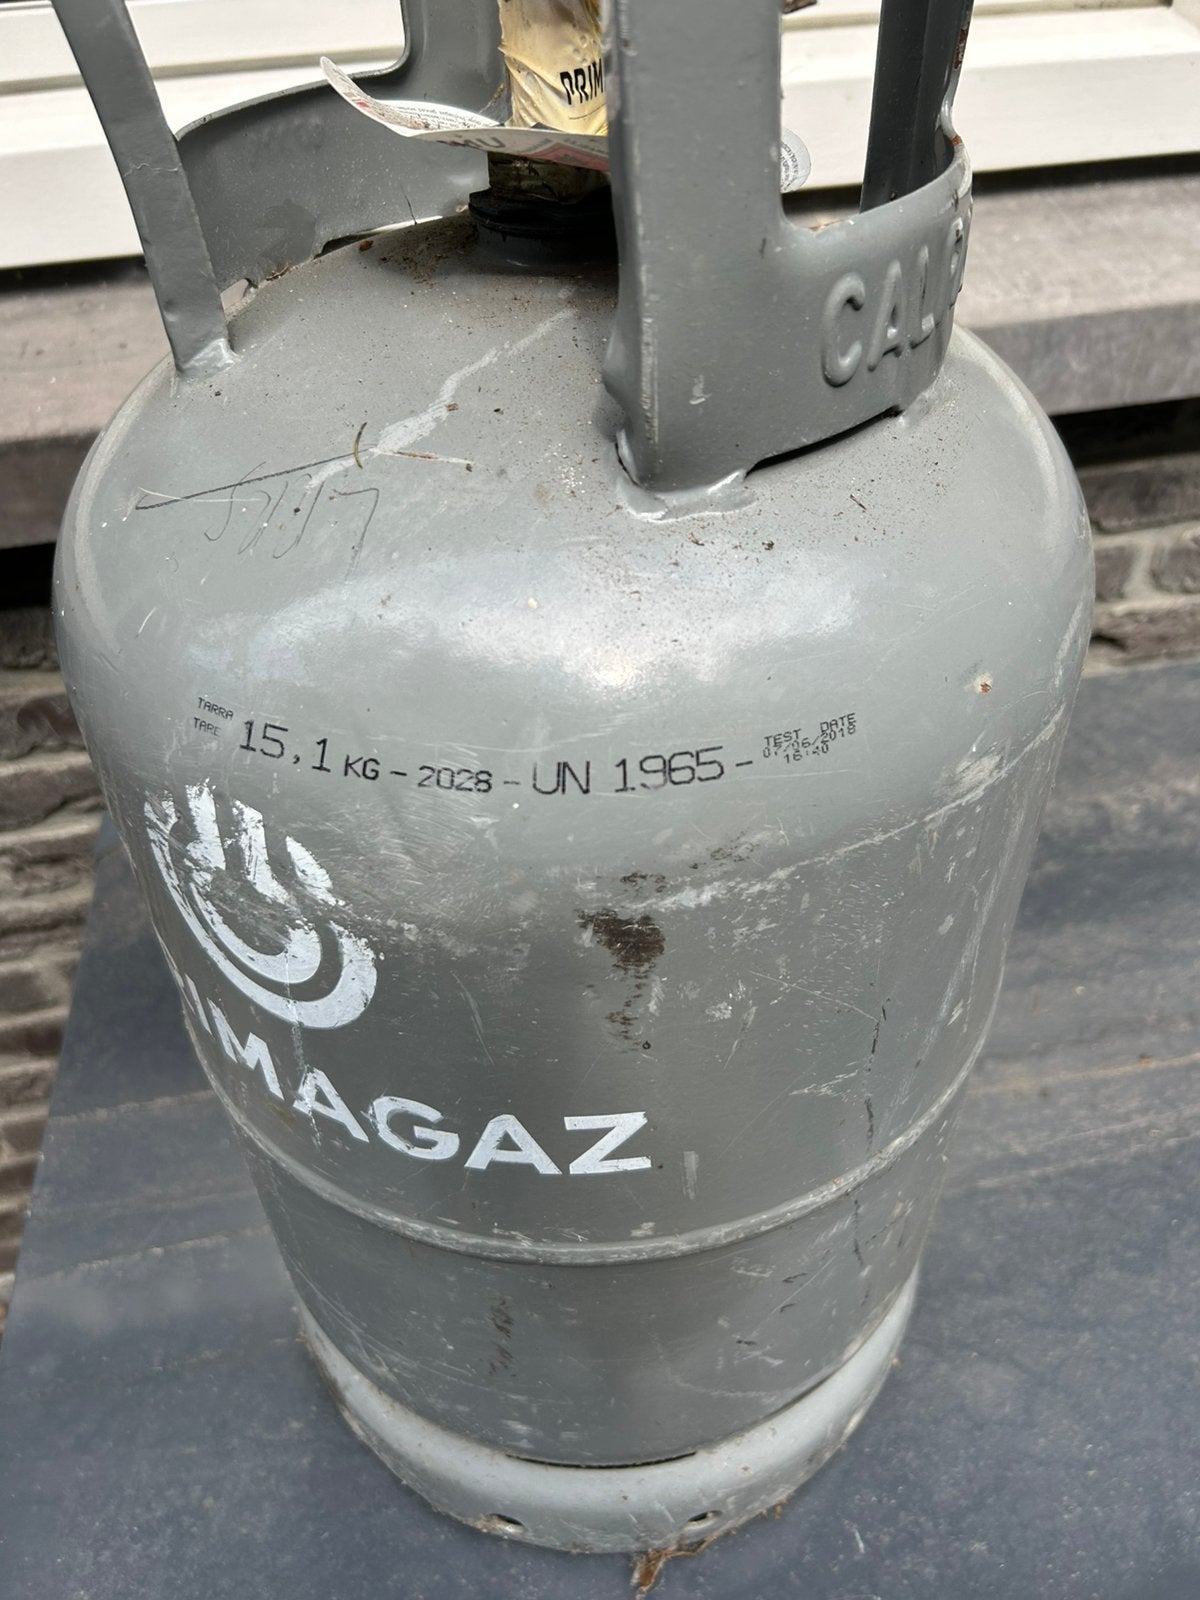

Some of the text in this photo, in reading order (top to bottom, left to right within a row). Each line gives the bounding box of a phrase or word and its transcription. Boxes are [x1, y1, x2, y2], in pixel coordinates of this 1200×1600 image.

[198, 697, 234, 720] TARRA
[194, 717, 221, 737] TARE
[763, 712, 856, 748] TEST DATE
[239, 718, 332, 773] 15,1
[343, 754, 380, 781] KG
[417, 764, 493, 793] 2028
[532, 760, 590, 795] UN
[614, 745, 725, 793] 1965
